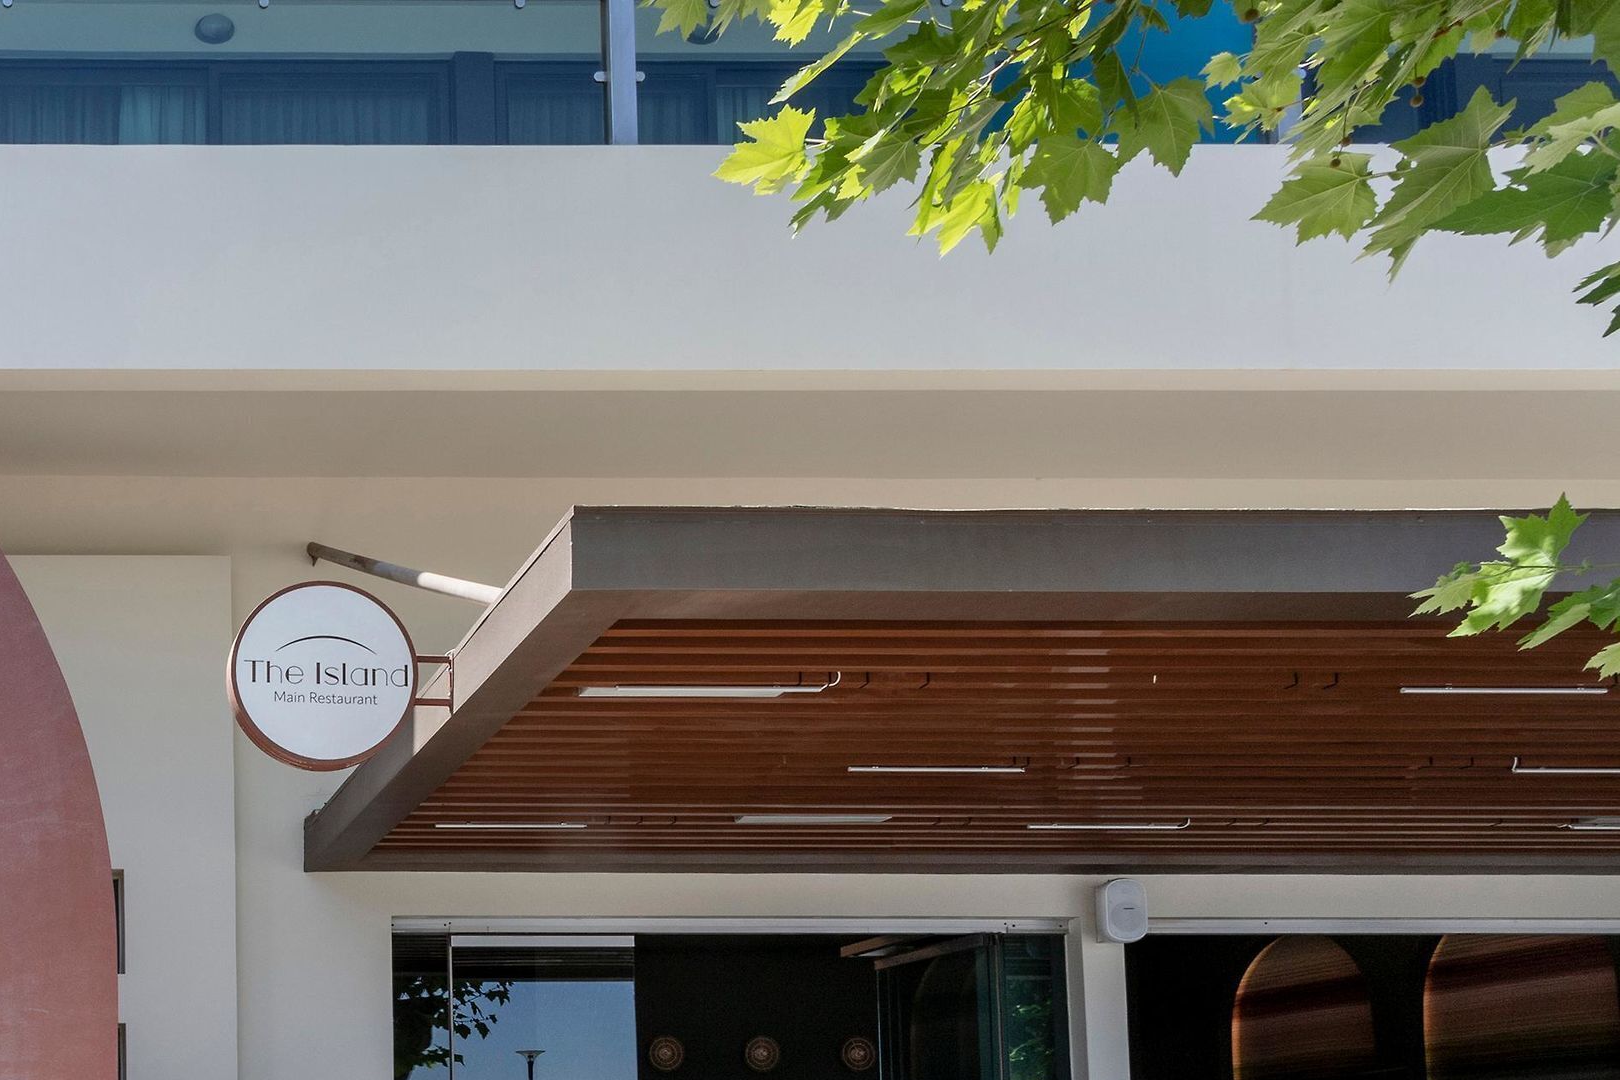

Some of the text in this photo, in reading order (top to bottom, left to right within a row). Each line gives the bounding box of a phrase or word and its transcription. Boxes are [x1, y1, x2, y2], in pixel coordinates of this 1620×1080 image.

[243, 659, 410, 688] The Island
[273, 690, 378, 706] Main Restaurant
